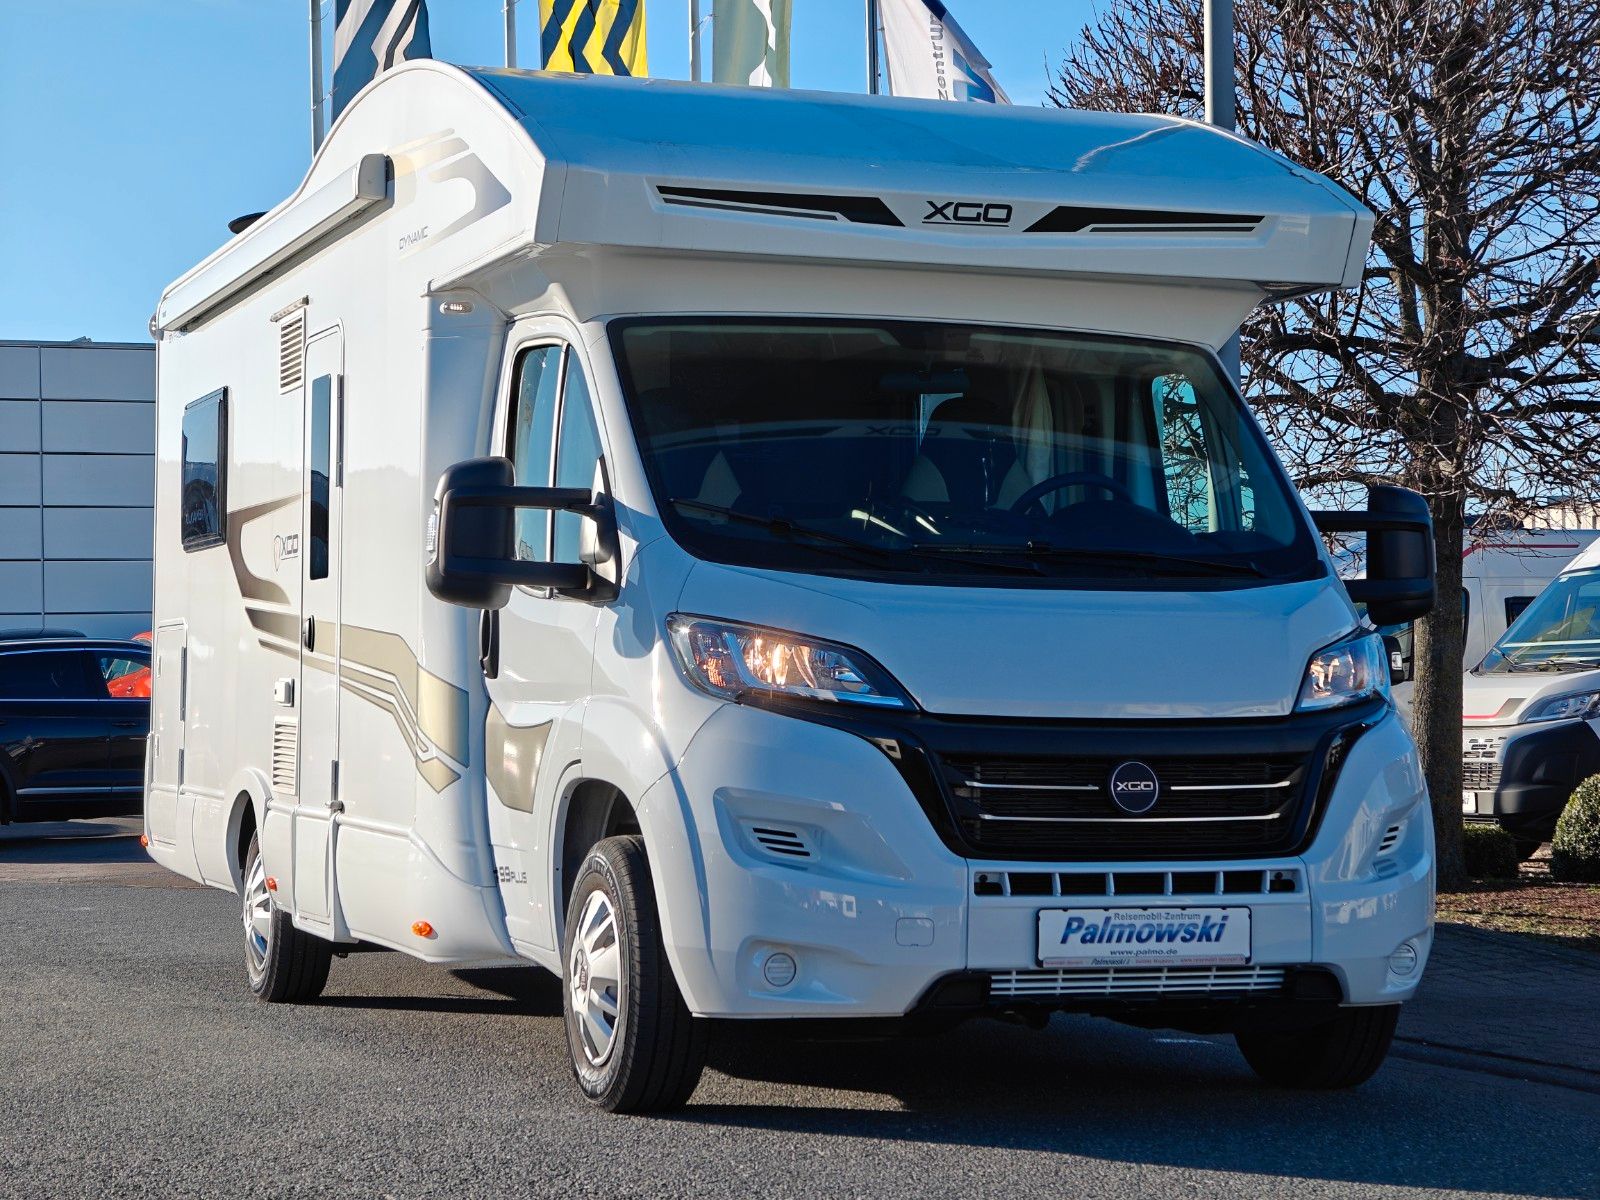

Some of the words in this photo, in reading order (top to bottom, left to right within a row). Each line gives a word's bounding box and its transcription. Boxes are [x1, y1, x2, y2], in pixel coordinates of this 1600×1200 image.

[923, 200, 1013, 223] XGO
[1116, 781, 1154, 791] XGO
[1113, 912, 1201, 921] Reisemobil-Zentrum
[1060, 914, 1229, 945] Palmowski
[1110, 948, 1178, 957] www.palmo.de
